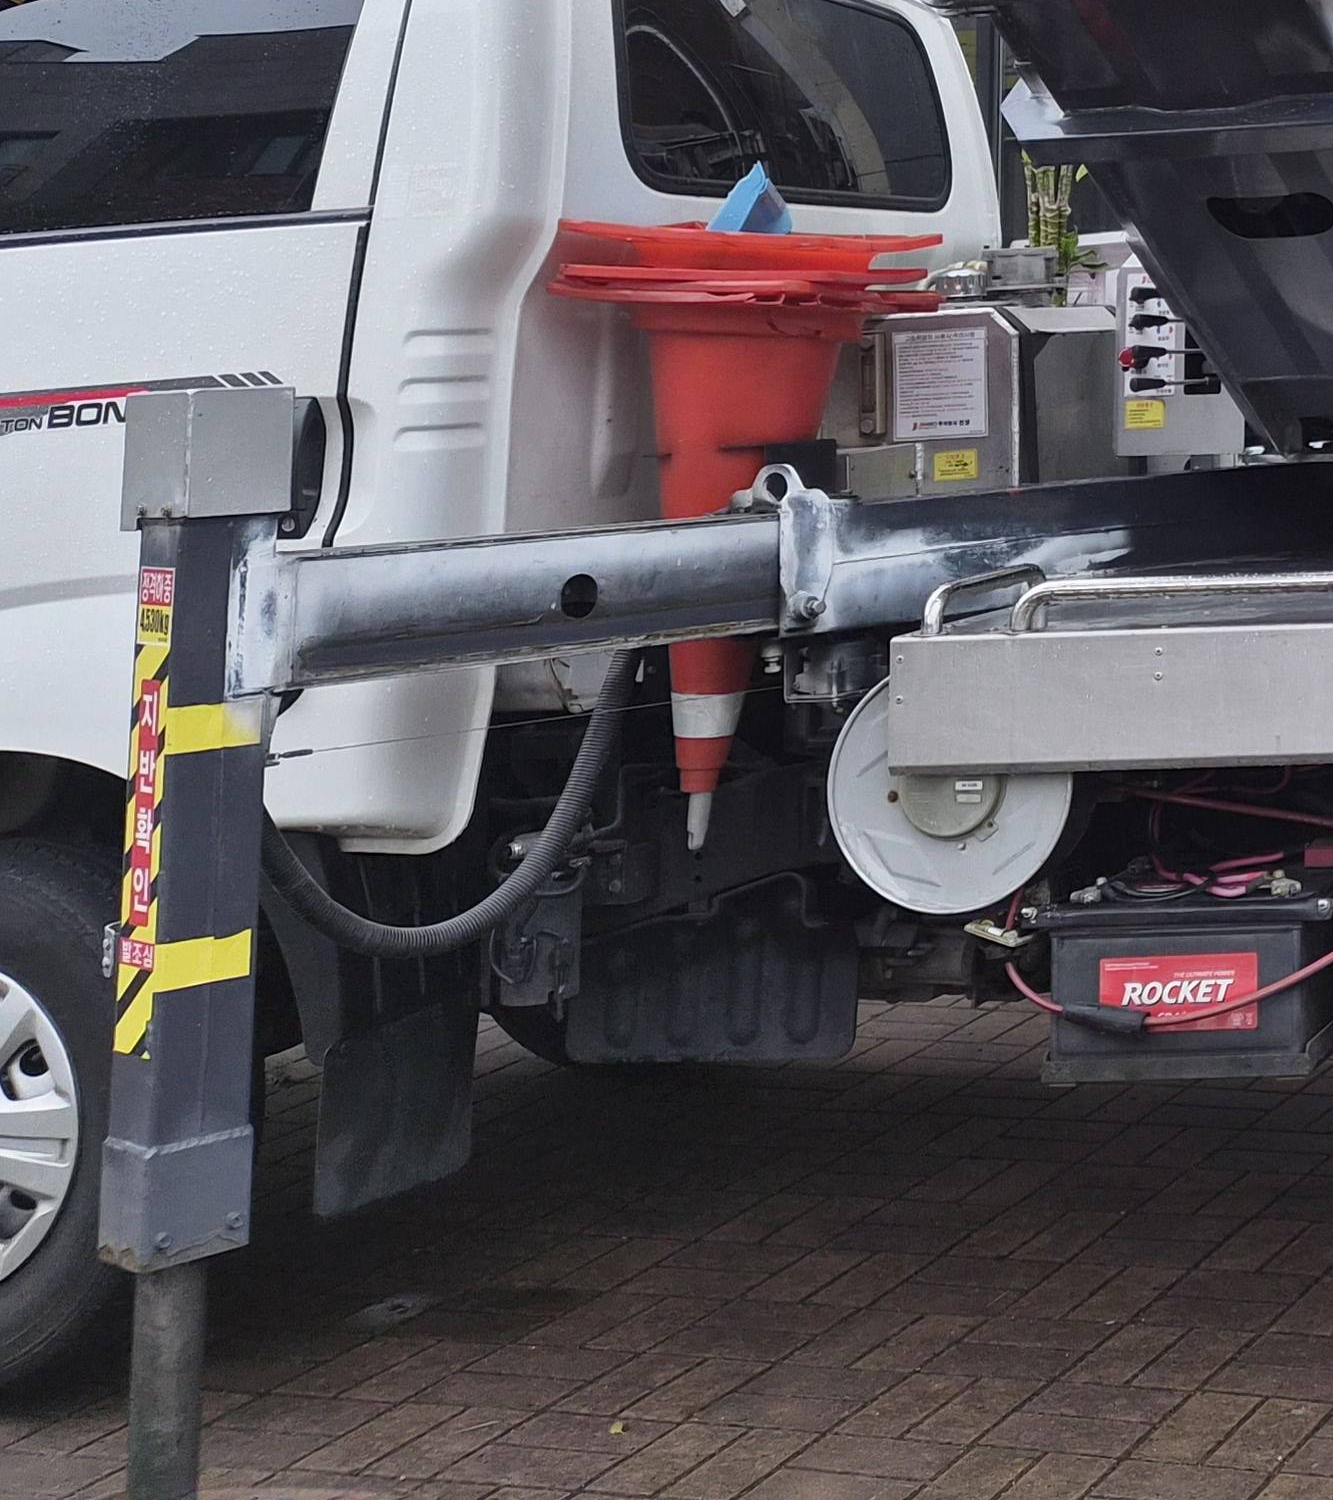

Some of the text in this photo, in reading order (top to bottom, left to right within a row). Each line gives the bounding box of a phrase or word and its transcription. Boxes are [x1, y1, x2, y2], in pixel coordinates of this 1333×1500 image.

[142, 572, 173, 603] 정격하중
[132, 692, 158, 912] 지반확인
[120, 941, 155, 968] 발조심
[1121, 978, 1235, 1007] ROCKET
